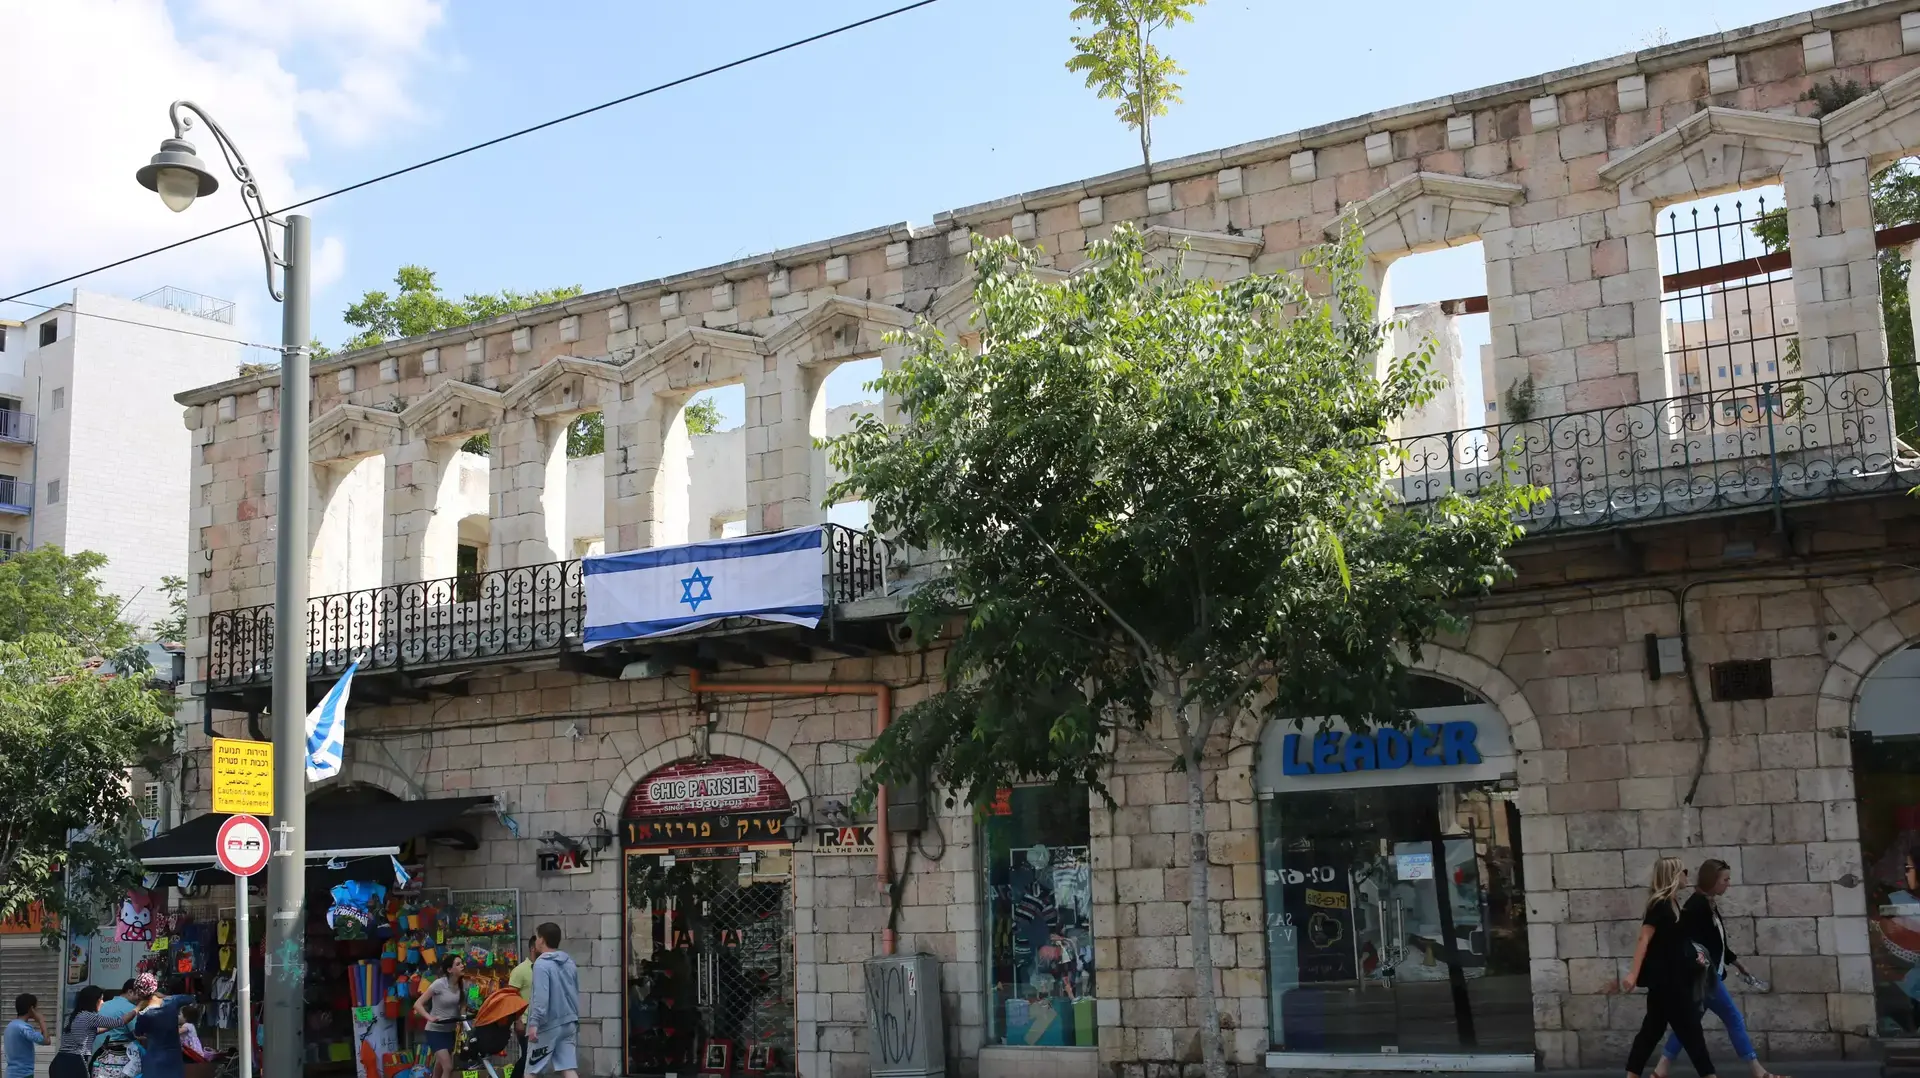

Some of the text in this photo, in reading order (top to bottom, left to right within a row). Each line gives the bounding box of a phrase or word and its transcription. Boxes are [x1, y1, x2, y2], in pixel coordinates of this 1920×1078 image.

[219, 746, 240, 754] תנועת
[1283, 721, 1482, 775] LEADER
[218, 757, 269, 767] רכבות דו סטרית
[650, 775, 757, 800] CHIC PARISIEN
[664, 799, 720, 812] SINCE 1930
[628, 818, 781, 844] שיק פריזיאן
[816, 827, 874, 846] TRAK
[539, 849, 589, 871] TRAK
[531, 1045, 549, 1059] NIKE
